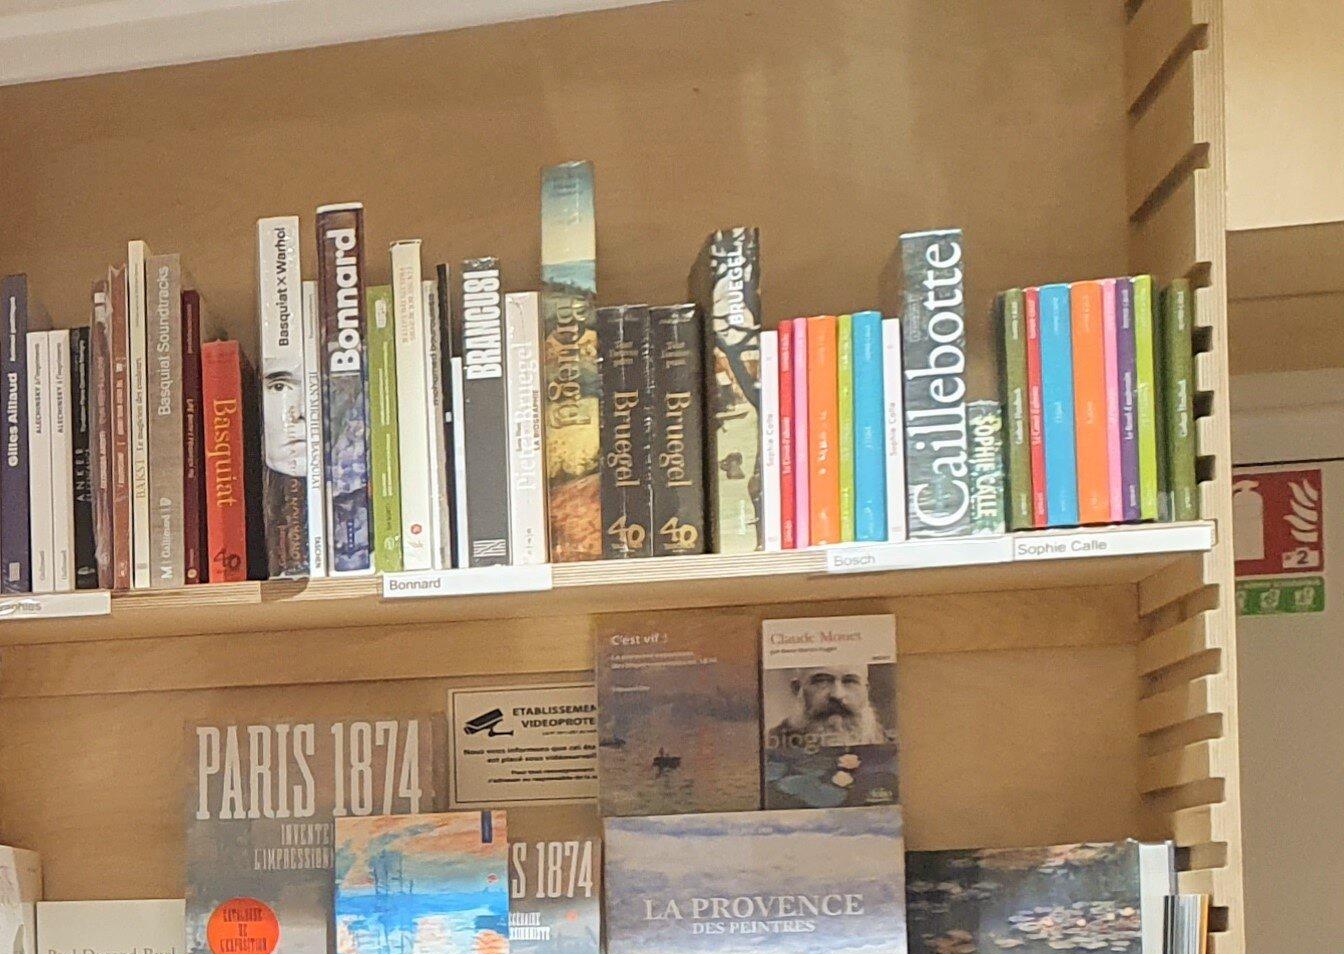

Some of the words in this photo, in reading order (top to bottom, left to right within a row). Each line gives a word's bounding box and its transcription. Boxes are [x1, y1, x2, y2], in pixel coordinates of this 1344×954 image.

[273, 226, 288, 275] Warhol
[156, 266, 171, 353] Soundtracks
[326, 227, 361, 372] Bonnard
[726, 242, 746, 326] BRUEGEL
[274, 286, 293, 347] Basquiat
[463, 268, 502, 379] BRANCUSI
[7, 373, 19, 424] Aillaud
[158, 354, 174, 416] Basquiat
[905, 240, 969, 528] Caillebotte
[7, 426, 18, 467] Gilles
[207, 398, 237, 507] Basquiat
[608, 388, 641, 489] Bruegel
[659, 390, 692, 488] Bruegel
[833, 553, 876, 568] Bosch
[1017, 541, 1067, 558] Sophie
[1070, 537, 1107, 552] Calle
[1296, 550, 1309, 565] 2
[389, 578, 441, 591] Bonnard
[770, 632, 815, 645] Claude
[820, 630, 862, 643] Monet
[196, 723, 315, 820] PARIS
[331, 719, 423, 816] 1874
[535, 840, 594, 900] 1874
[644, 900, 683, 921] LA
[692, 893, 864, 919] PROVENCE
[692, 921, 726, 935] DES
[728, 919, 816, 934] PEINTRES
